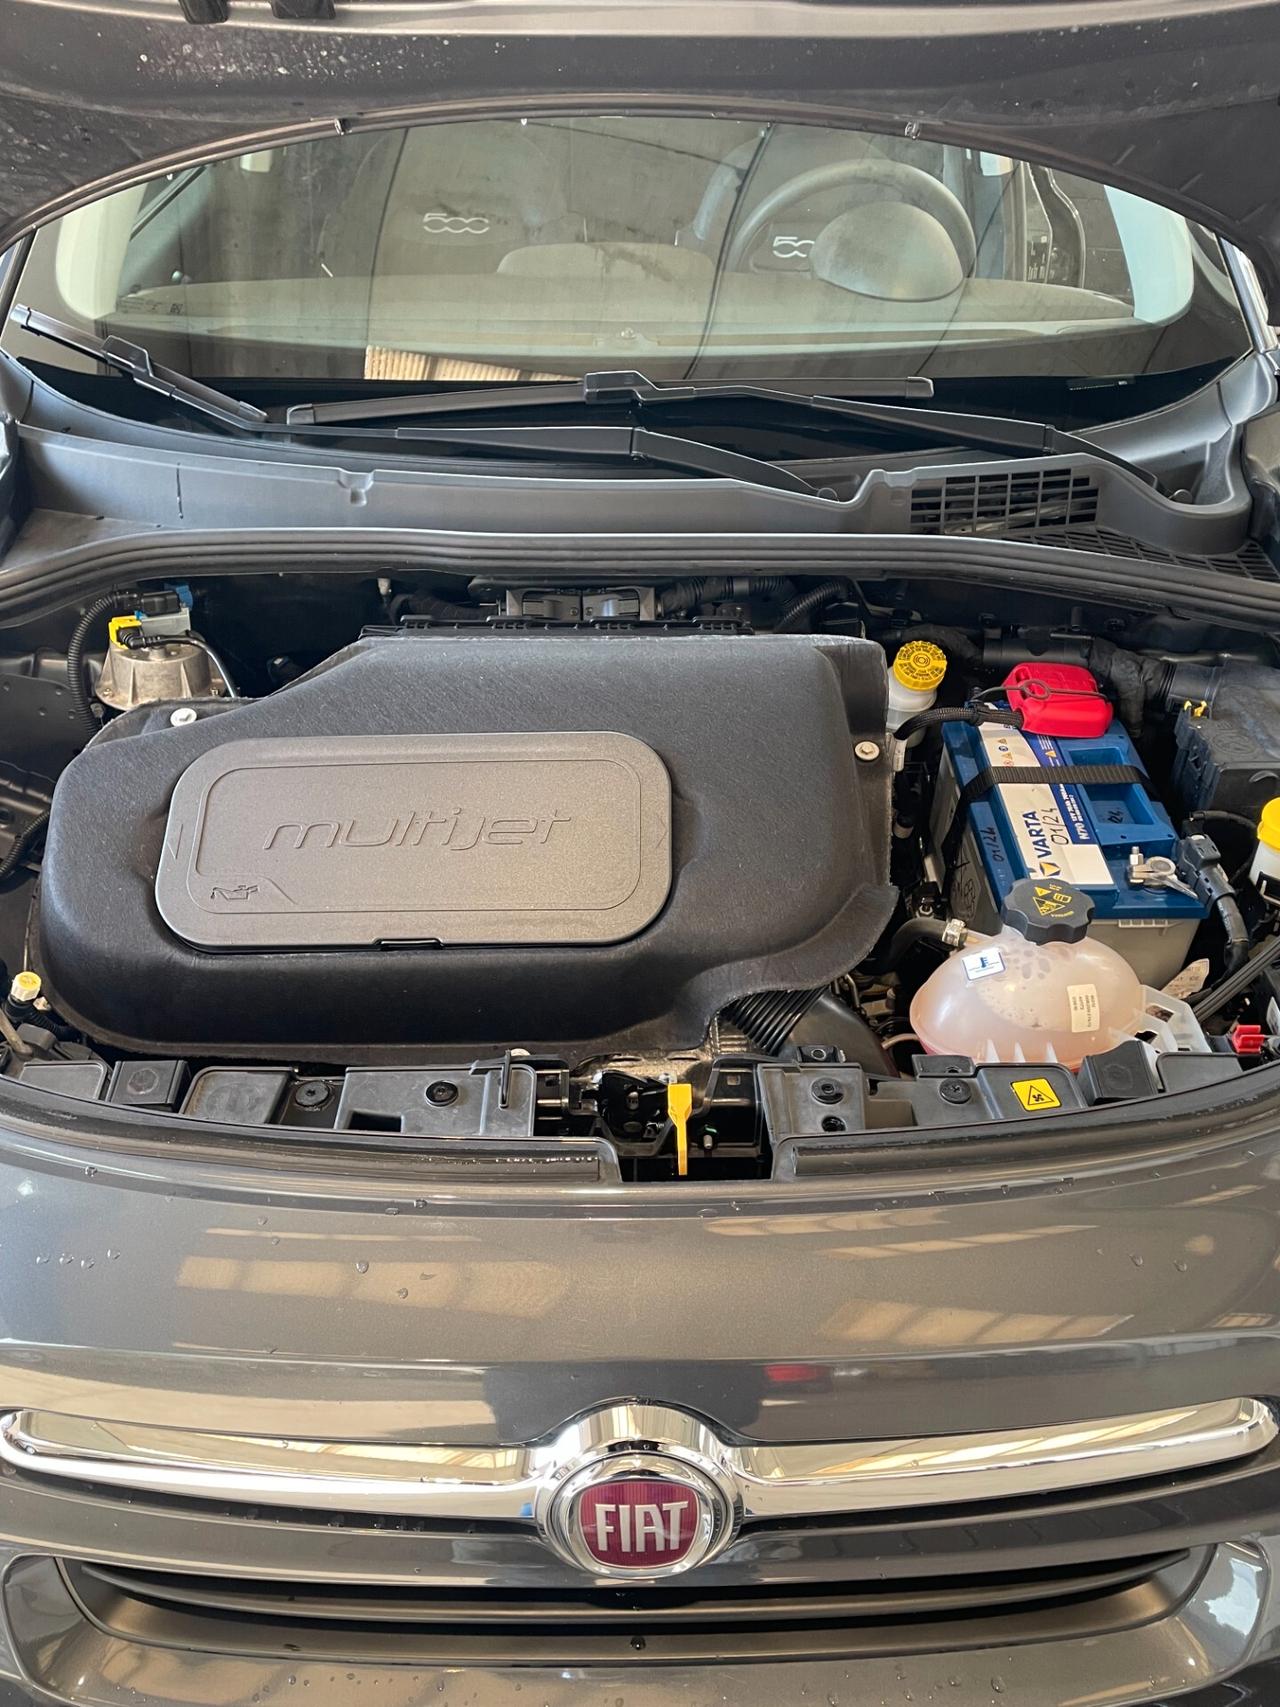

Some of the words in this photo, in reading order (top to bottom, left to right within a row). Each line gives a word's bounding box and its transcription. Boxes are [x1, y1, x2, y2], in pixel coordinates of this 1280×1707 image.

[422, 212, 490, 234] 500
[773, 235, 816, 258] 50
[262, 807, 571, 851] multijet
[980, 827, 1004, 861] 01/24
[1022, 811, 1050, 858] VARTA
[1041, 807, 1070, 846] 01/24
[595, 1502, 688, 1552] FIAT
